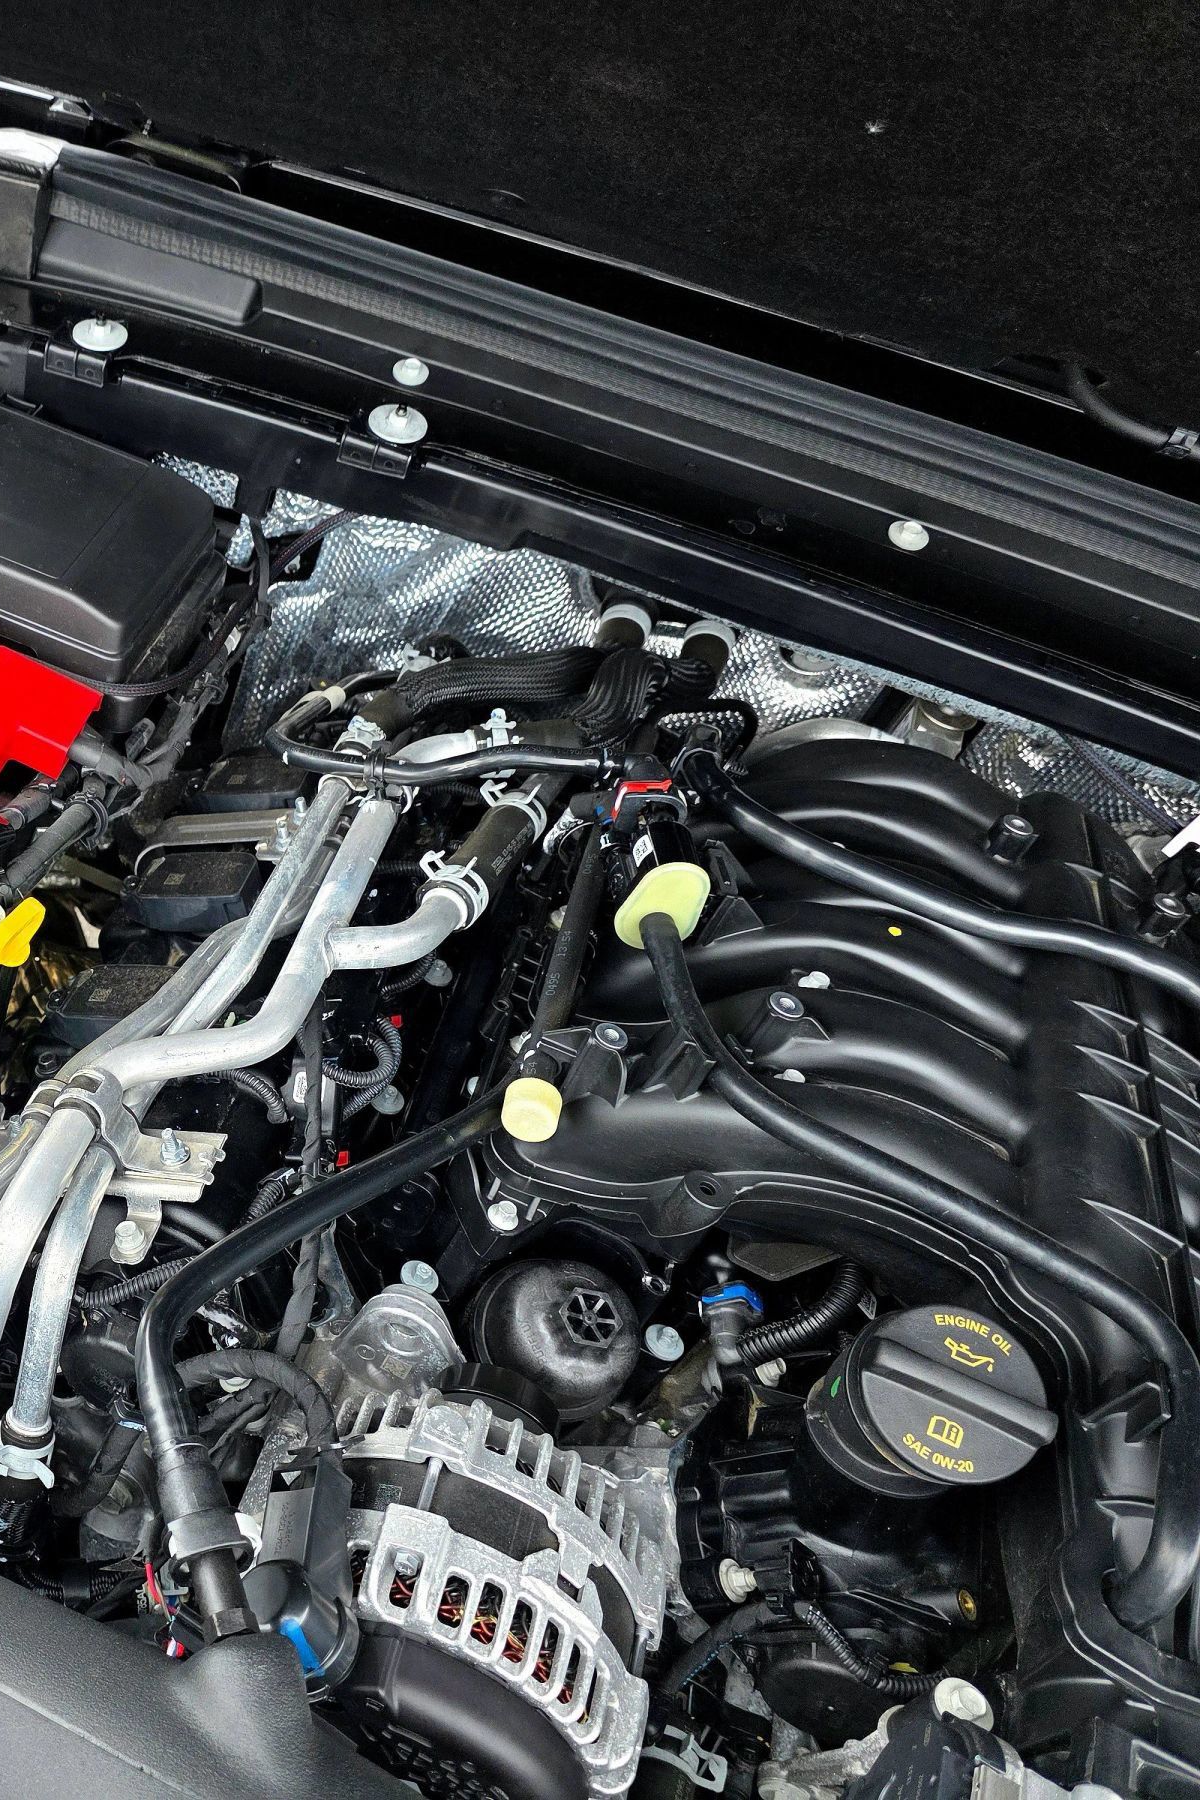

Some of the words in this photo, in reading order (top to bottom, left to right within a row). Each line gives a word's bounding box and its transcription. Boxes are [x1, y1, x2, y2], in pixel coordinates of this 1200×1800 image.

[933, 1313, 992, 1338] ENGINE
[991, 1332, 1012, 1357] OIL
[902, 1433, 930, 1461] SAE
[932, 1452, 975, 1474] 0W-20
